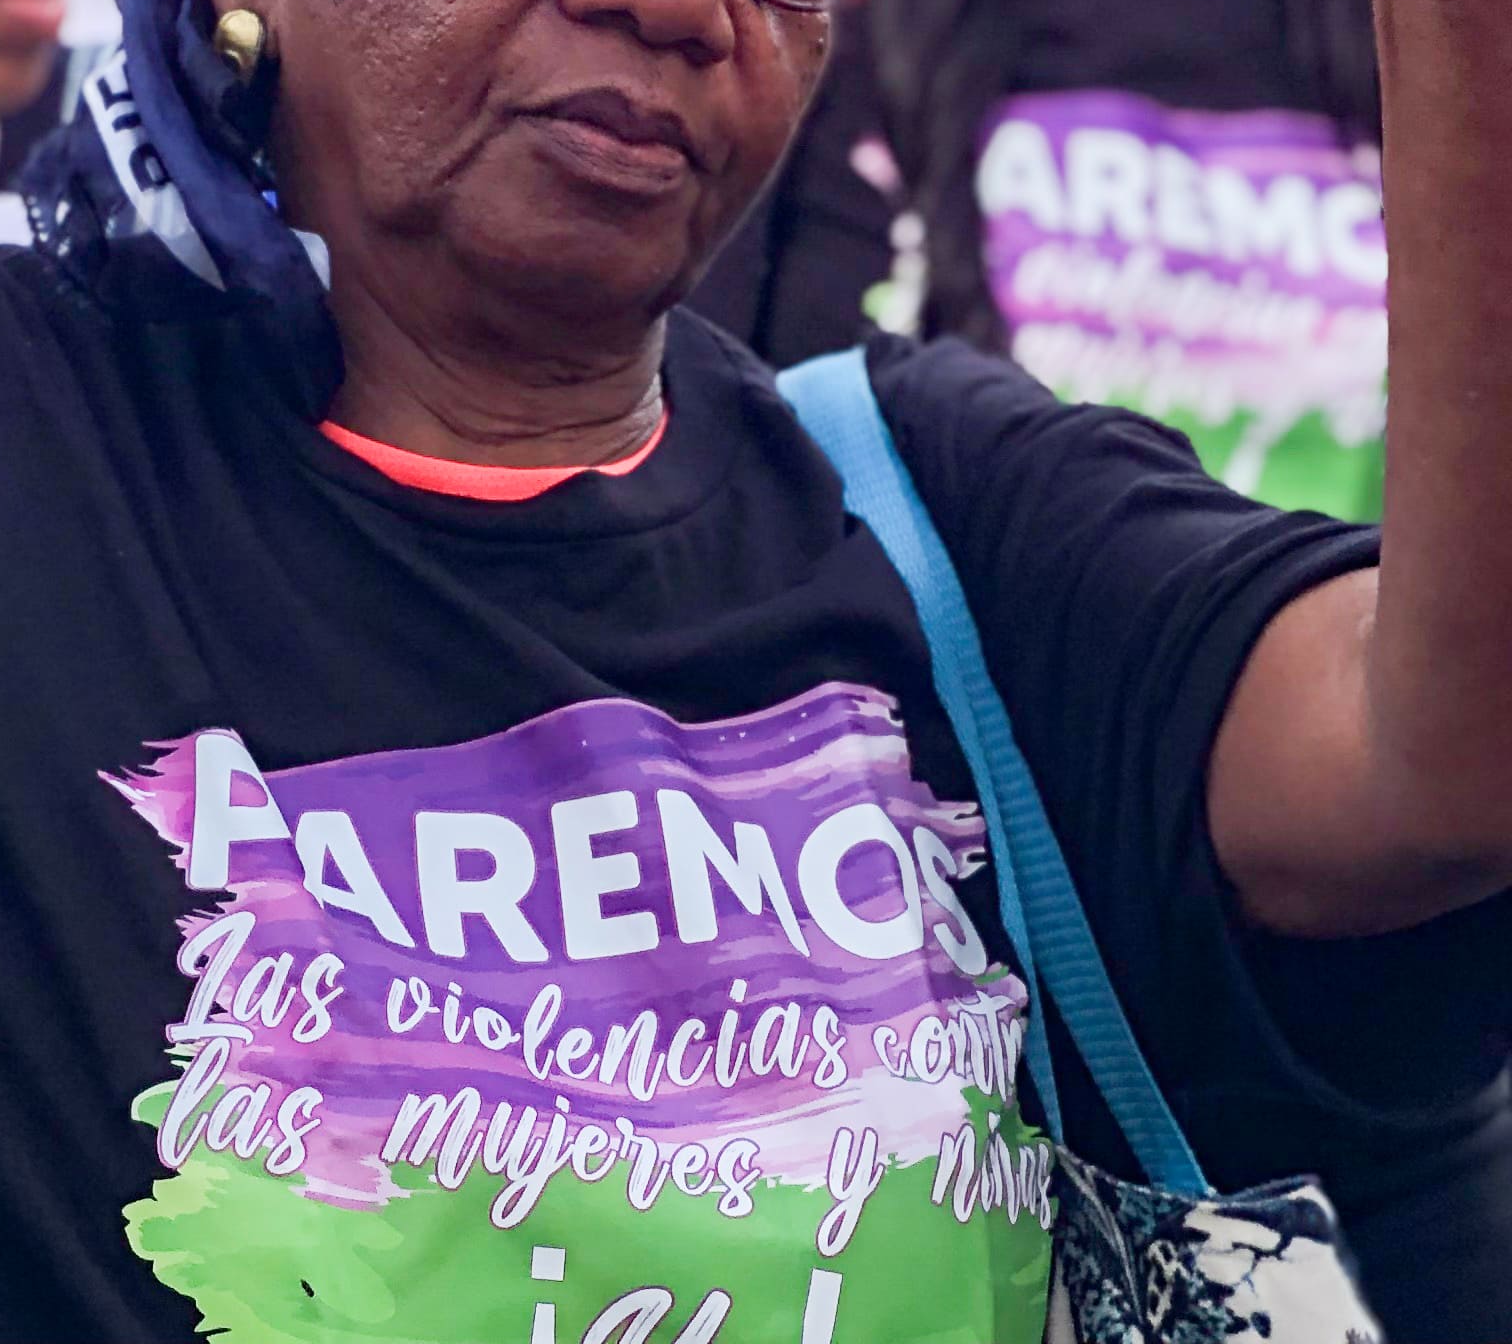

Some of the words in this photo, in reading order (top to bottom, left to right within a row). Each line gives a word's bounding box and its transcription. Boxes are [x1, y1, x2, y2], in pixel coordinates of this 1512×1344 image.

[185, 729, 990, 976] PAREMOS
[164, 909, 346, 1045] Las
[385, 974, 849, 1103] violencias
[157, 1035, 325, 1177] las
[380, 1086, 762, 1231] mujeres
[815, 1126, 885, 1258] y
